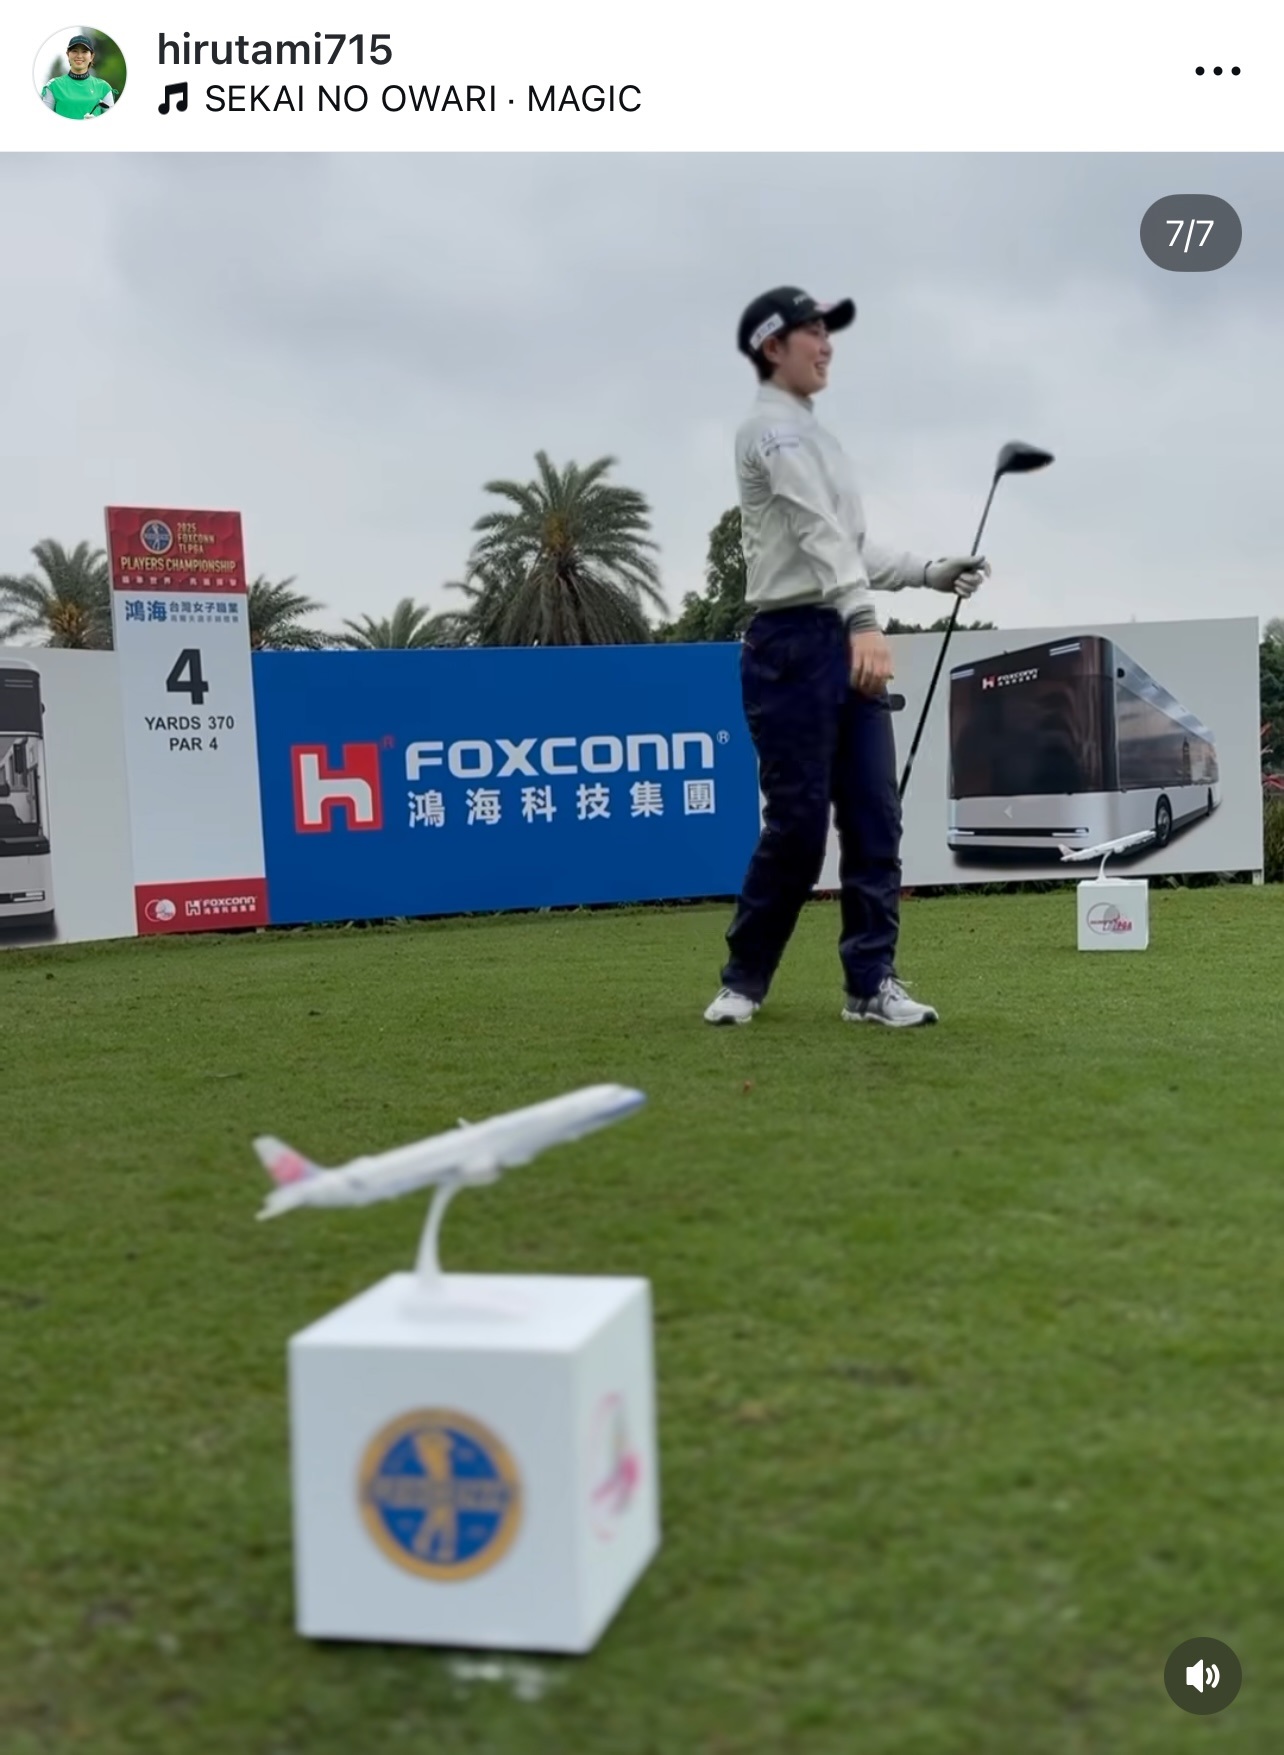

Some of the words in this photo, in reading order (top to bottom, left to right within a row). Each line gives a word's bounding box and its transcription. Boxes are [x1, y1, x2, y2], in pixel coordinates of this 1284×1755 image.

[177, 523, 197, 533] 2025
[177, 533, 215, 544] FOXCONN
[120, 556, 164, 571] PLAYERS
[165, 558, 236, 573] CHAMPIONSHIP
[125, 600, 167, 622] 鴻海
[165, 648, 209, 706] 4
[144, 716, 202, 731] YARDS
[208, 715, 235, 730] 370
[169, 737, 203, 751] PAR
[209, 737, 218, 751] 4
[405, 732, 715, 781] FOXCONN
[407, 779, 717, 829] 鴻海科技集團
[203, 896, 255, 907] FOXCONN
